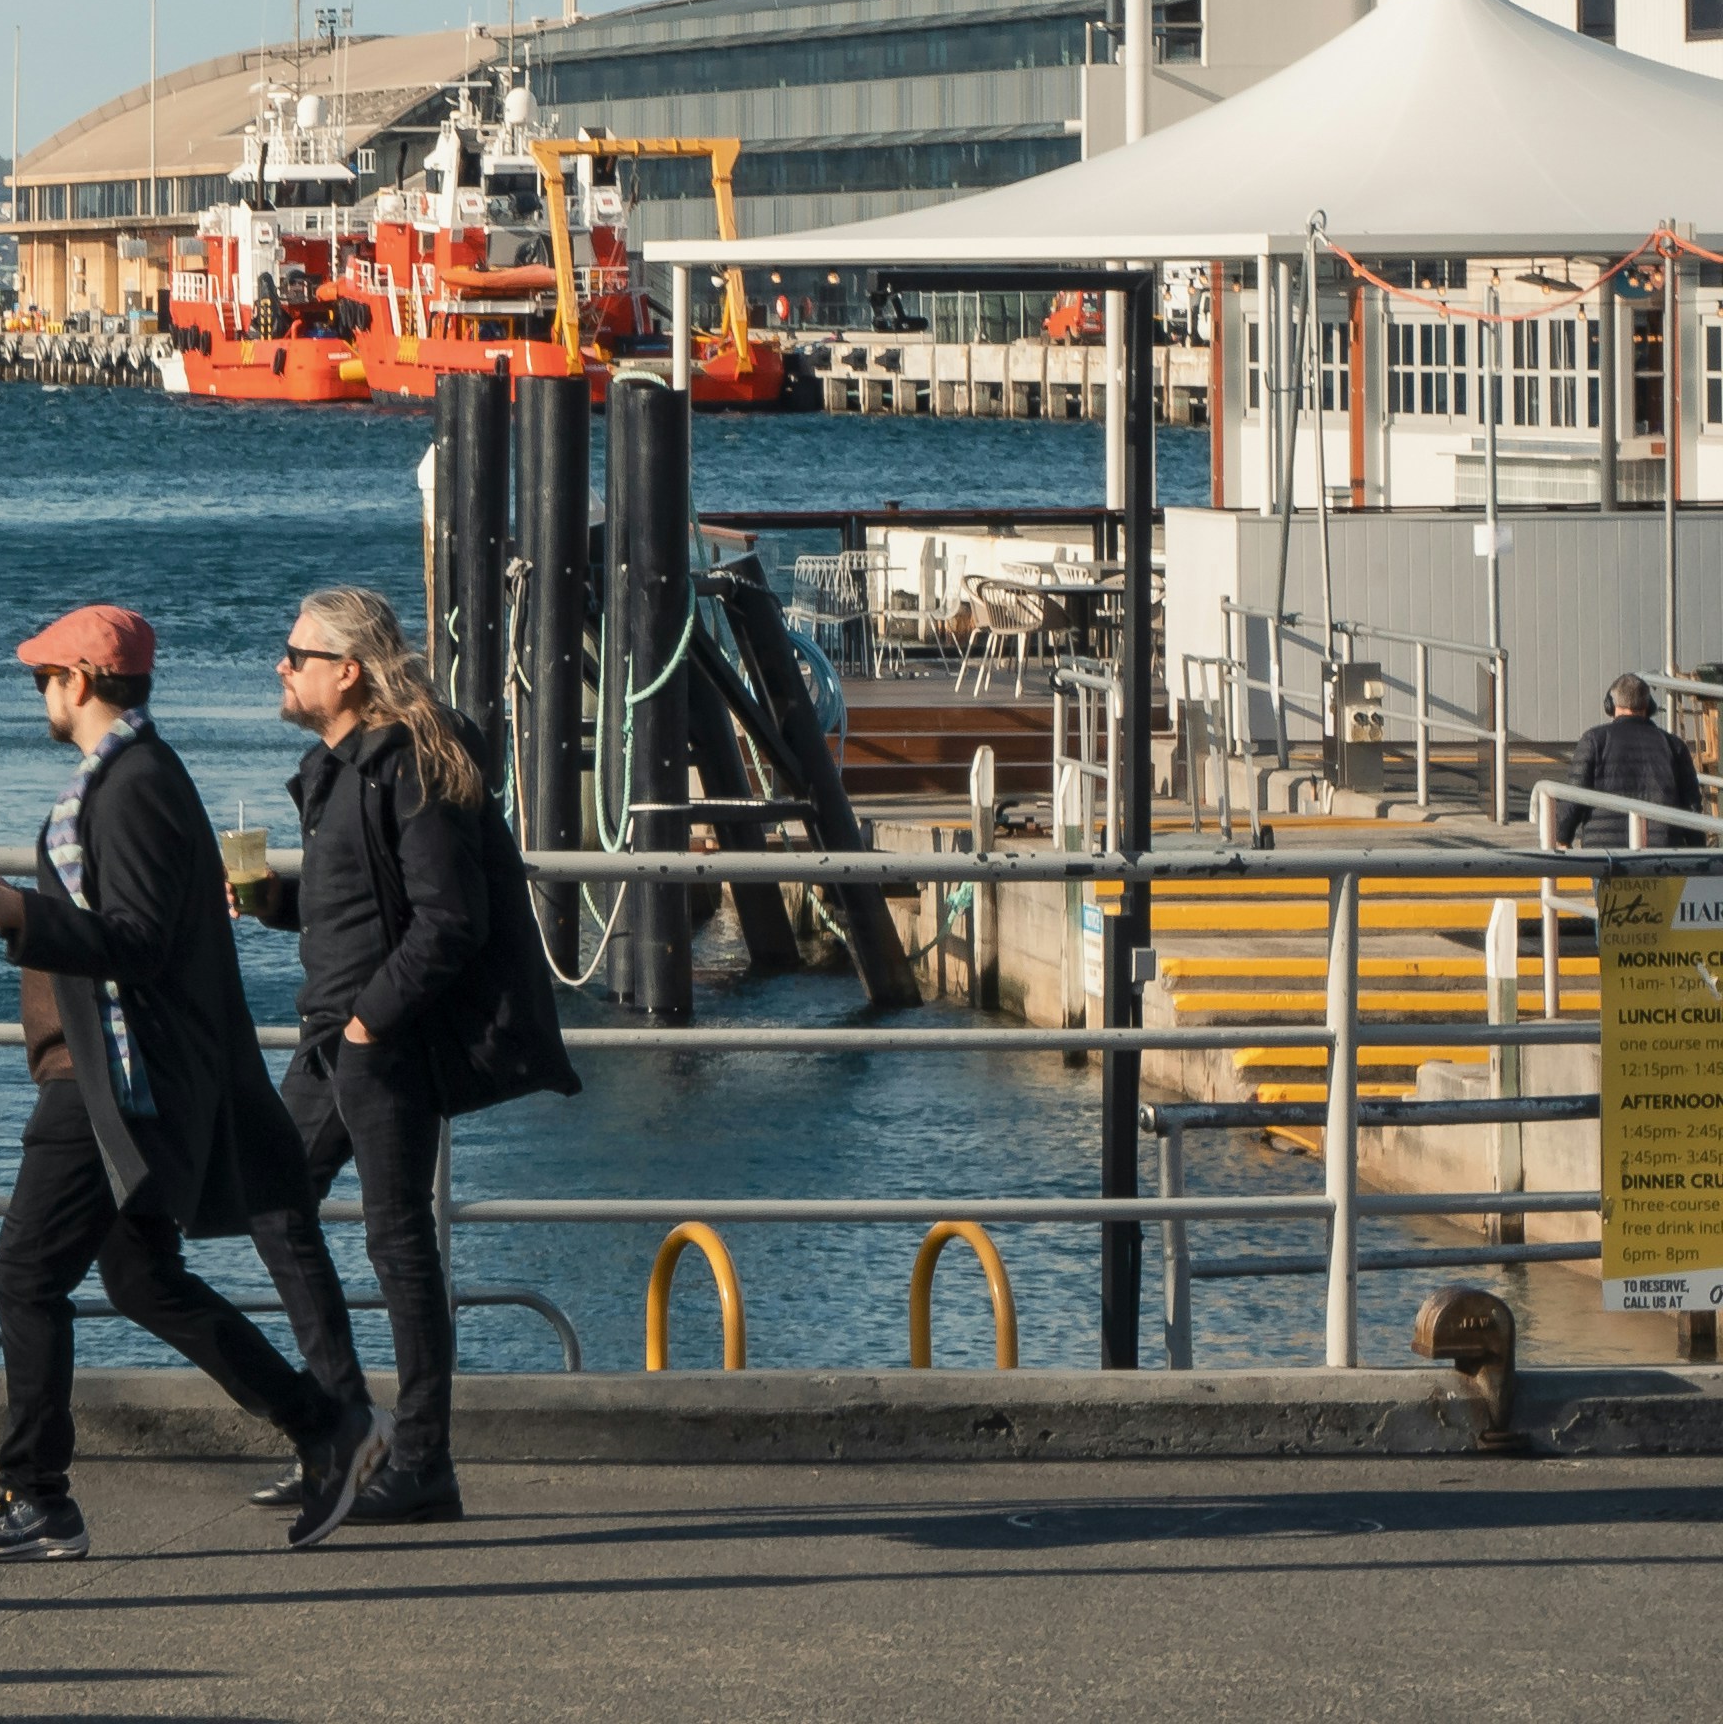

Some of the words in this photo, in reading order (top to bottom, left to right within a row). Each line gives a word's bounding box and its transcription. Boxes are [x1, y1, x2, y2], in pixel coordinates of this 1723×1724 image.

[1600, 893, 1664, 929] Historic
[1603, 932, 1659, 945] CRUISES
[1618, 951, 1704, 968] MORNING
[1618, 1008, 1677, 1025] LUNCH
[1619, 1039, 1648, 1051] one
[1652, 1038, 1702, 1051] course
[1620, 1093, 1723, 1110] AFTERNOON
[1621, 1173, 1686, 1190] DINNER
[1622, 1198, 1720, 1212] Three-course
[1622, 1221, 1652, 1235] free
[1656, 1220, 1695, 1235] drink
[1666, 1246, 1700, 1264] 8pm
[1623, 1279, 1638, 1293] TO
[1640, 1279, 1690, 1294] RESERVE,
[1623, 1296, 1650, 1309] CALL
[1653, 1296, 1667, 1309] US
[1669, 1295, 1683, 1309] AT
